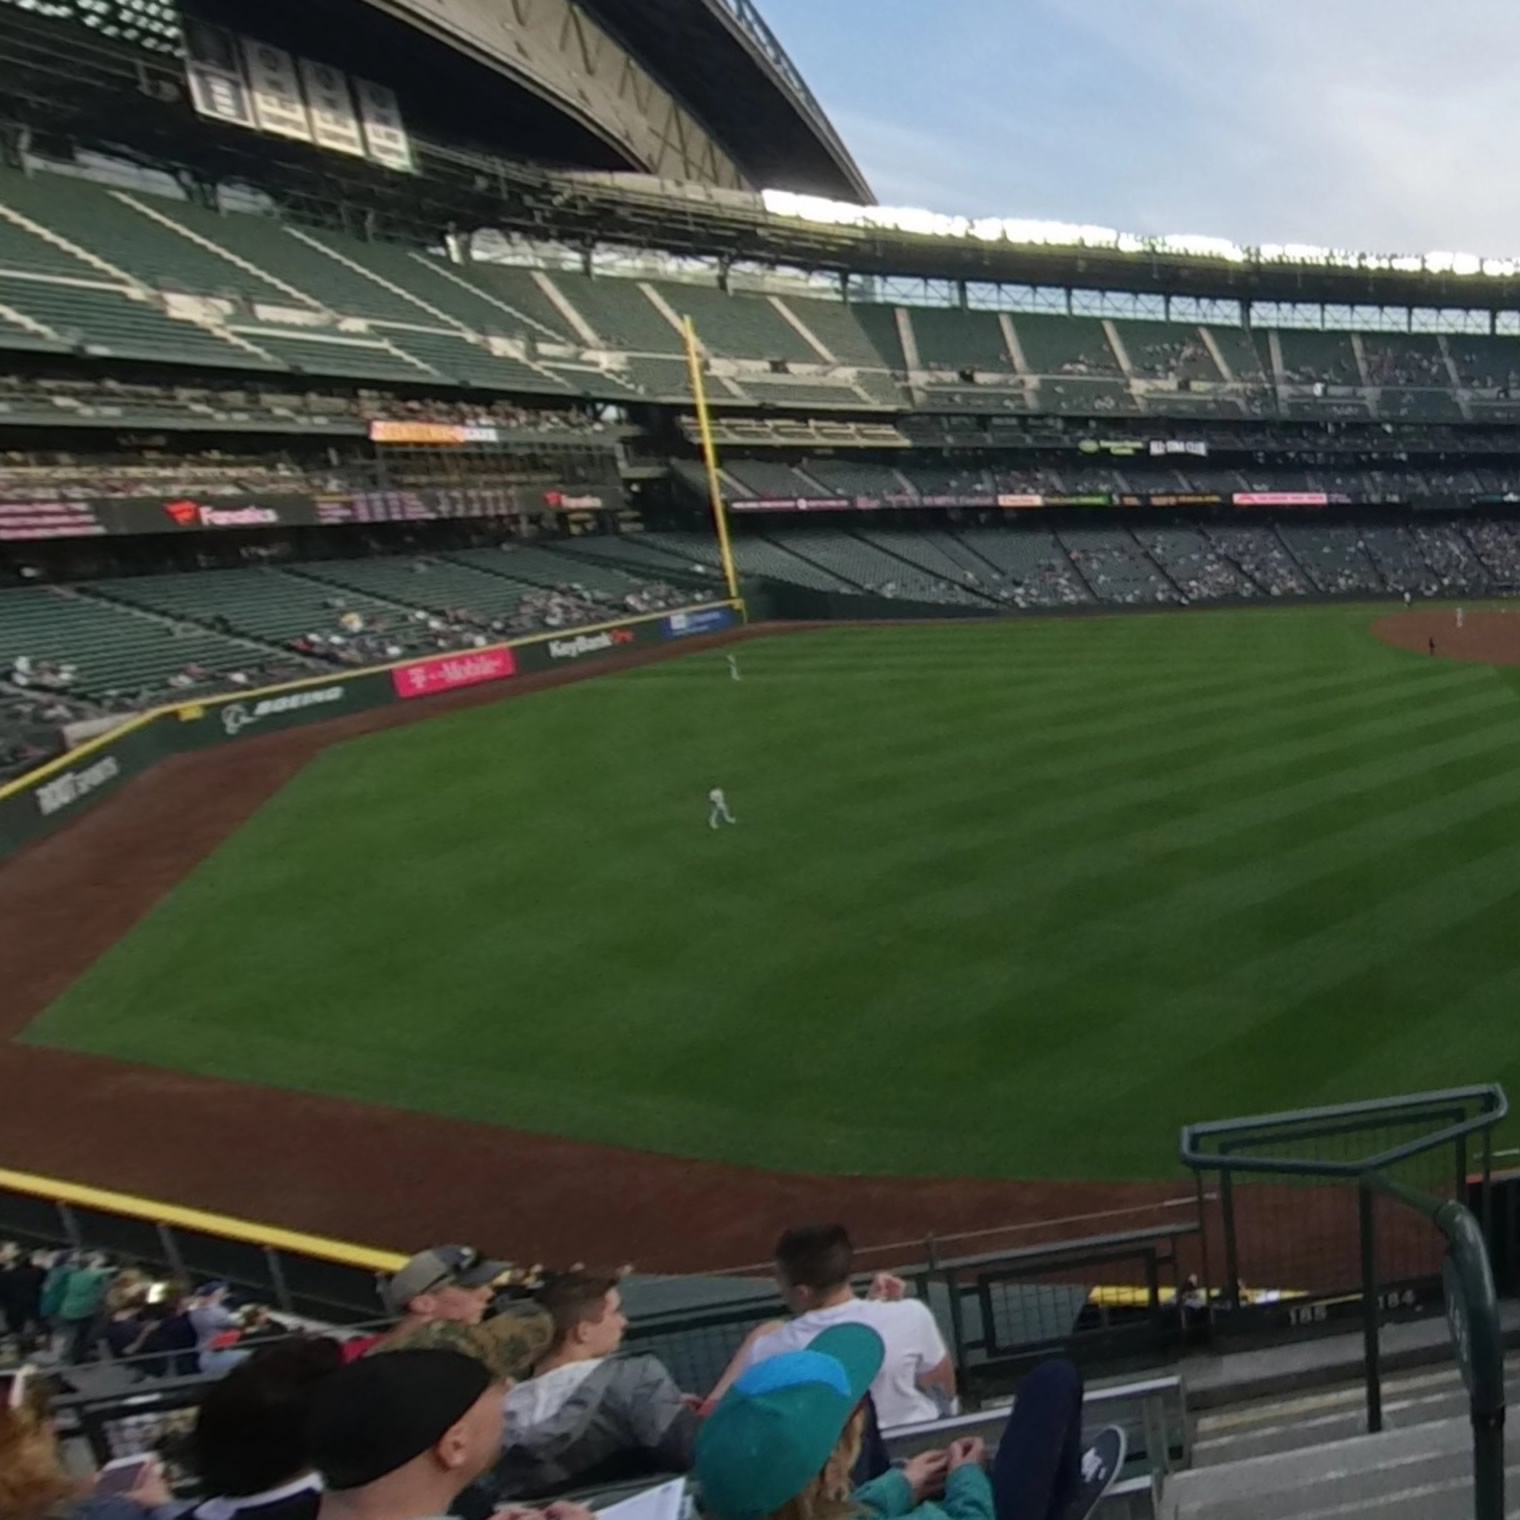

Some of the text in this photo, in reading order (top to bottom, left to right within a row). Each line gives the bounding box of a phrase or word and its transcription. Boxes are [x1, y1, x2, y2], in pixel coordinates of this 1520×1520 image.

[199, 505, 278, 526] Fanatics
[548, 631, 613, 658] KeyBank
[254, 686, 345, 716] BOEING
[1378, 1289, 1416, 1310] 184
